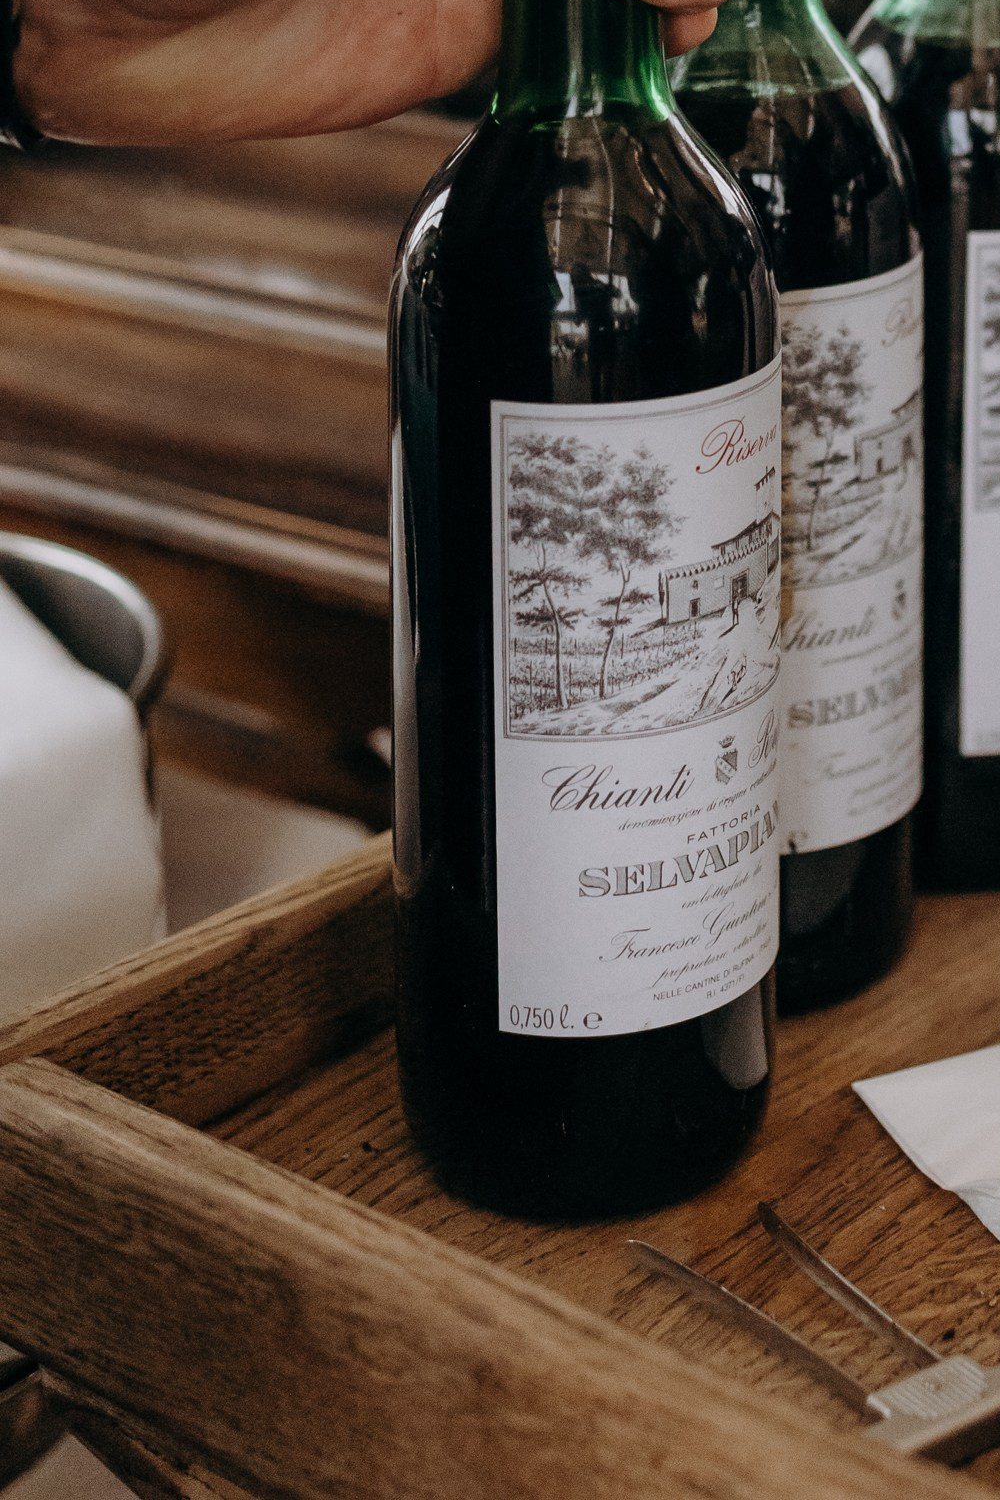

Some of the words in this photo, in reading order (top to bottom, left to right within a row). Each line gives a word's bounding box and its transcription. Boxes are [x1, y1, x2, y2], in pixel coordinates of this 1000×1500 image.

[695, 414, 778, 475] Riserva
[541, 763, 696, 813] Chianti
[686, 804, 761, 845] FATTORIA
[599, 927, 701, 963] Francesco
[653, 986, 683, 1001] NELLE
[684, 973, 721, 994] CANTINE
[723, 968, 731, 979] DI
